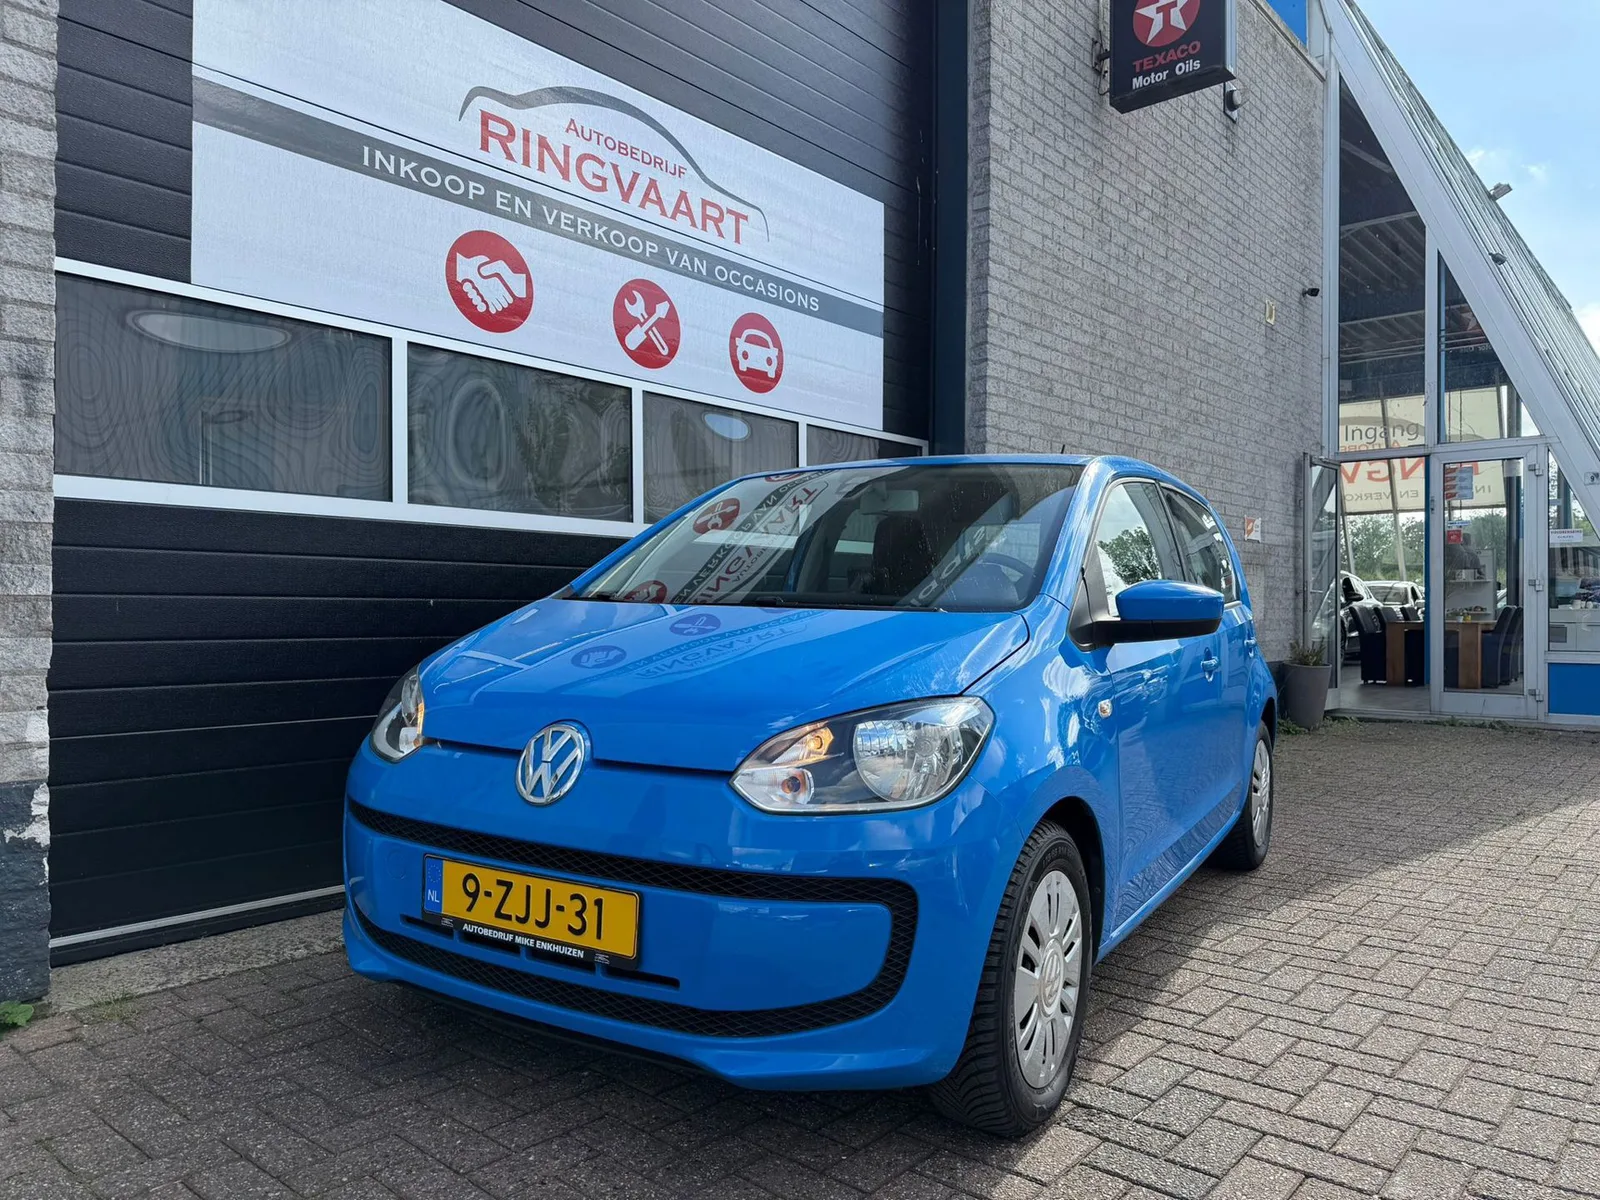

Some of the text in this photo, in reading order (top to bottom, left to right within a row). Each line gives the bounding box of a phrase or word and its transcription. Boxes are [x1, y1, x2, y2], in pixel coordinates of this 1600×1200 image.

[1132, 40, 1201, 73] TEXACO
[1132, 59, 1201, 90] Motor Oils
[564, 117, 688, 180] AUTOBEDRIJF
[478, 108, 749, 246] RINGVAART
[362, 145, 821, 313] INKOOP EN VERKOOP VAN OCCASIONS
[1344, 422, 1420, 445] Ingang
[427, 872, 604, 941] NL 9-ZJJ-31
[462, 923, 585, 959] AUTOBEDRIJF MIKE ENKHUIZEN
